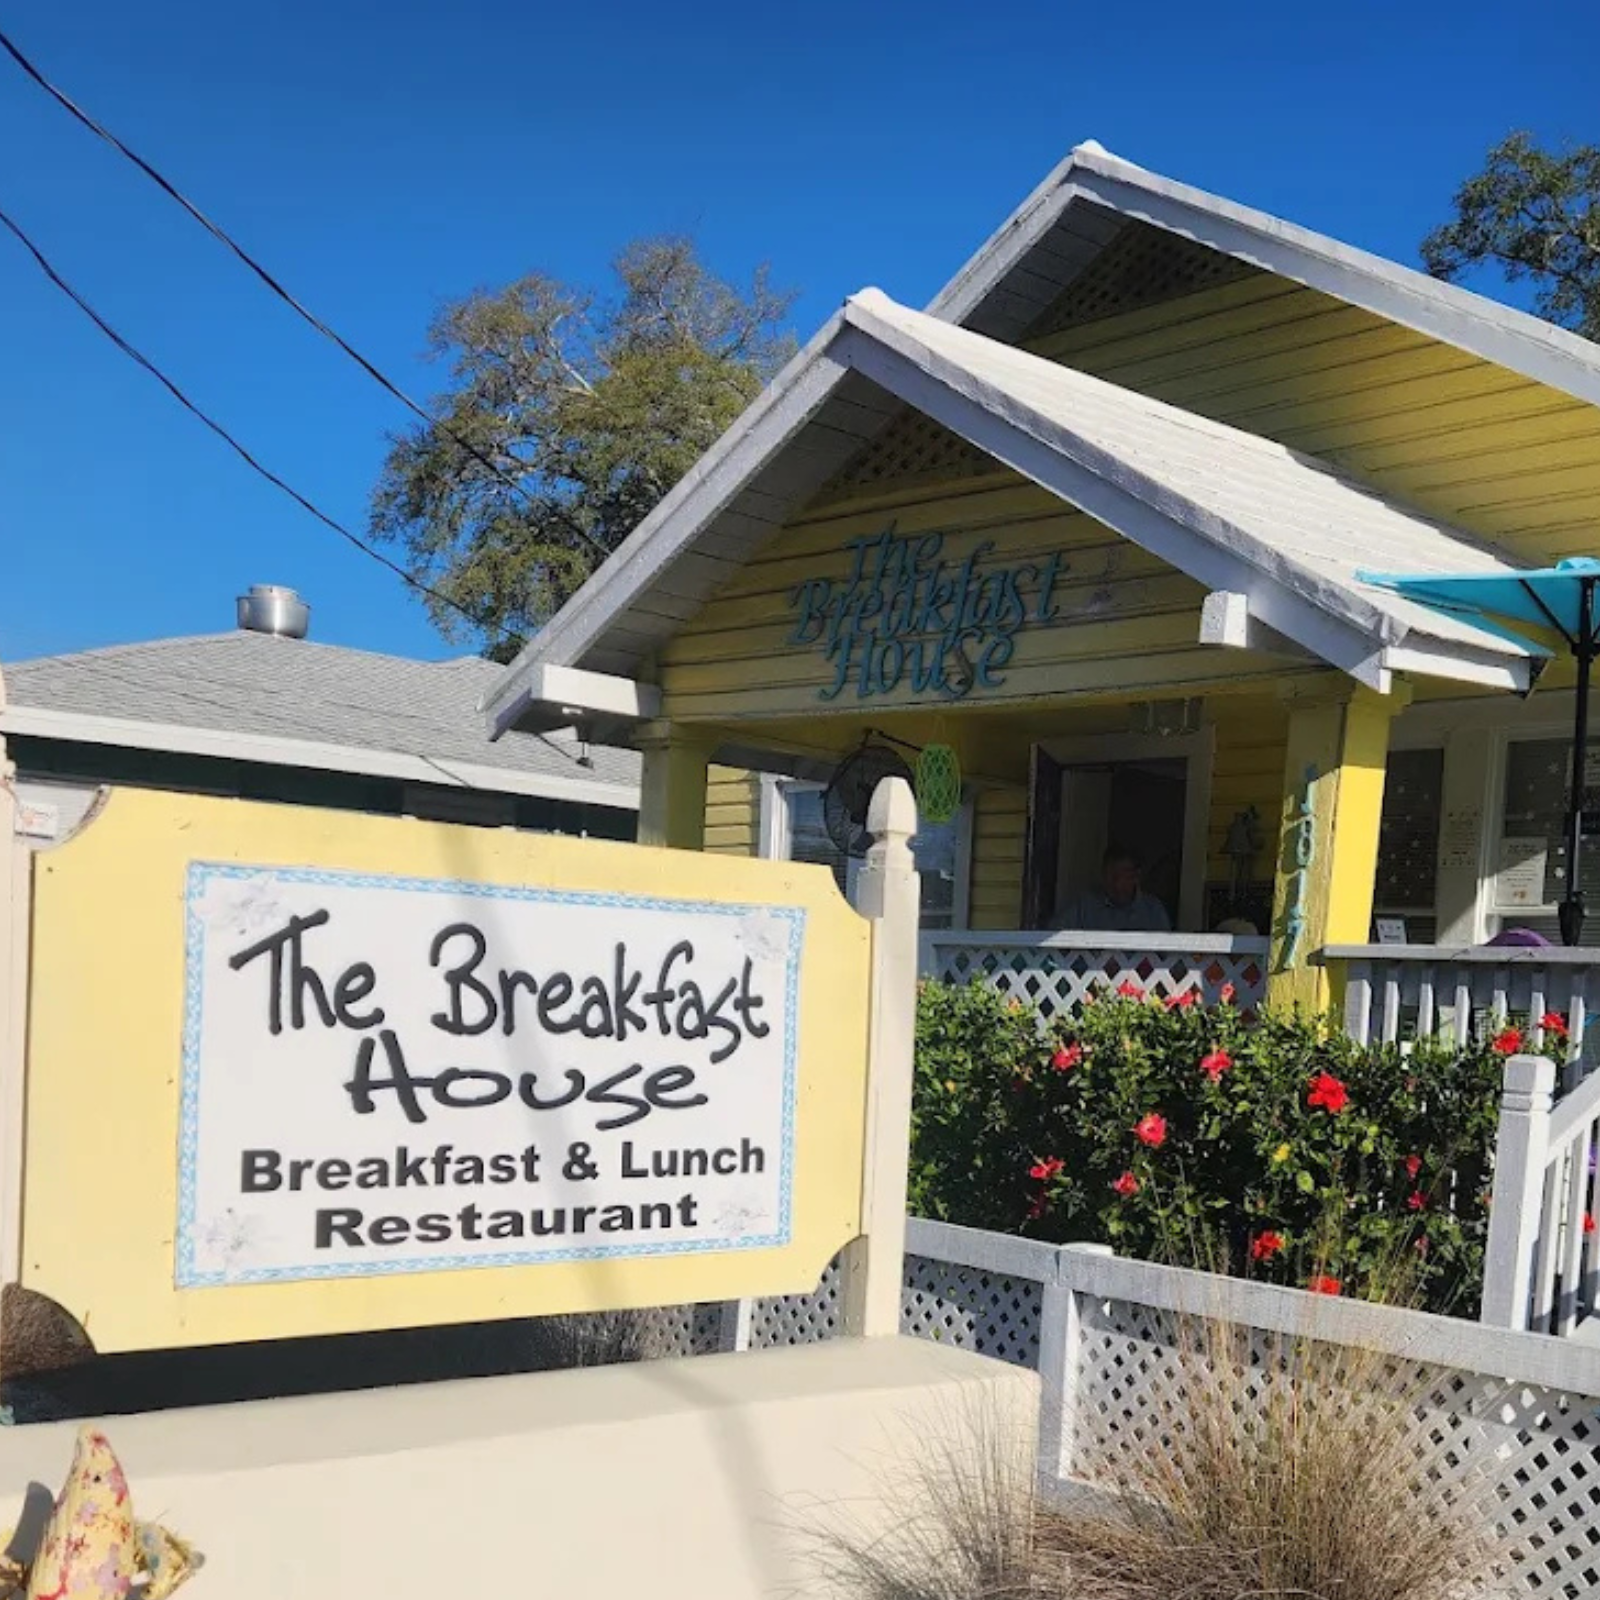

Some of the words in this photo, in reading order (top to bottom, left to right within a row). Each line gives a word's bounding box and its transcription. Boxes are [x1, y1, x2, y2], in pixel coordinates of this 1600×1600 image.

[844, 519, 944, 588] The
[787, 540, 1071, 661] Breakfast
[818, 627, 1014, 701] House
[229, 909, 385, 1036] The
[430, 923, 770, 1064] Breakfast
[344, 1029, 709, 1131] House
[240, 1145, 541, 1193] Breakfast
[562, 1141, 599, 1181] &
[621, 1138, 765, 1179] Lunch
[315, 1194, 698, 1248] Restaurant
